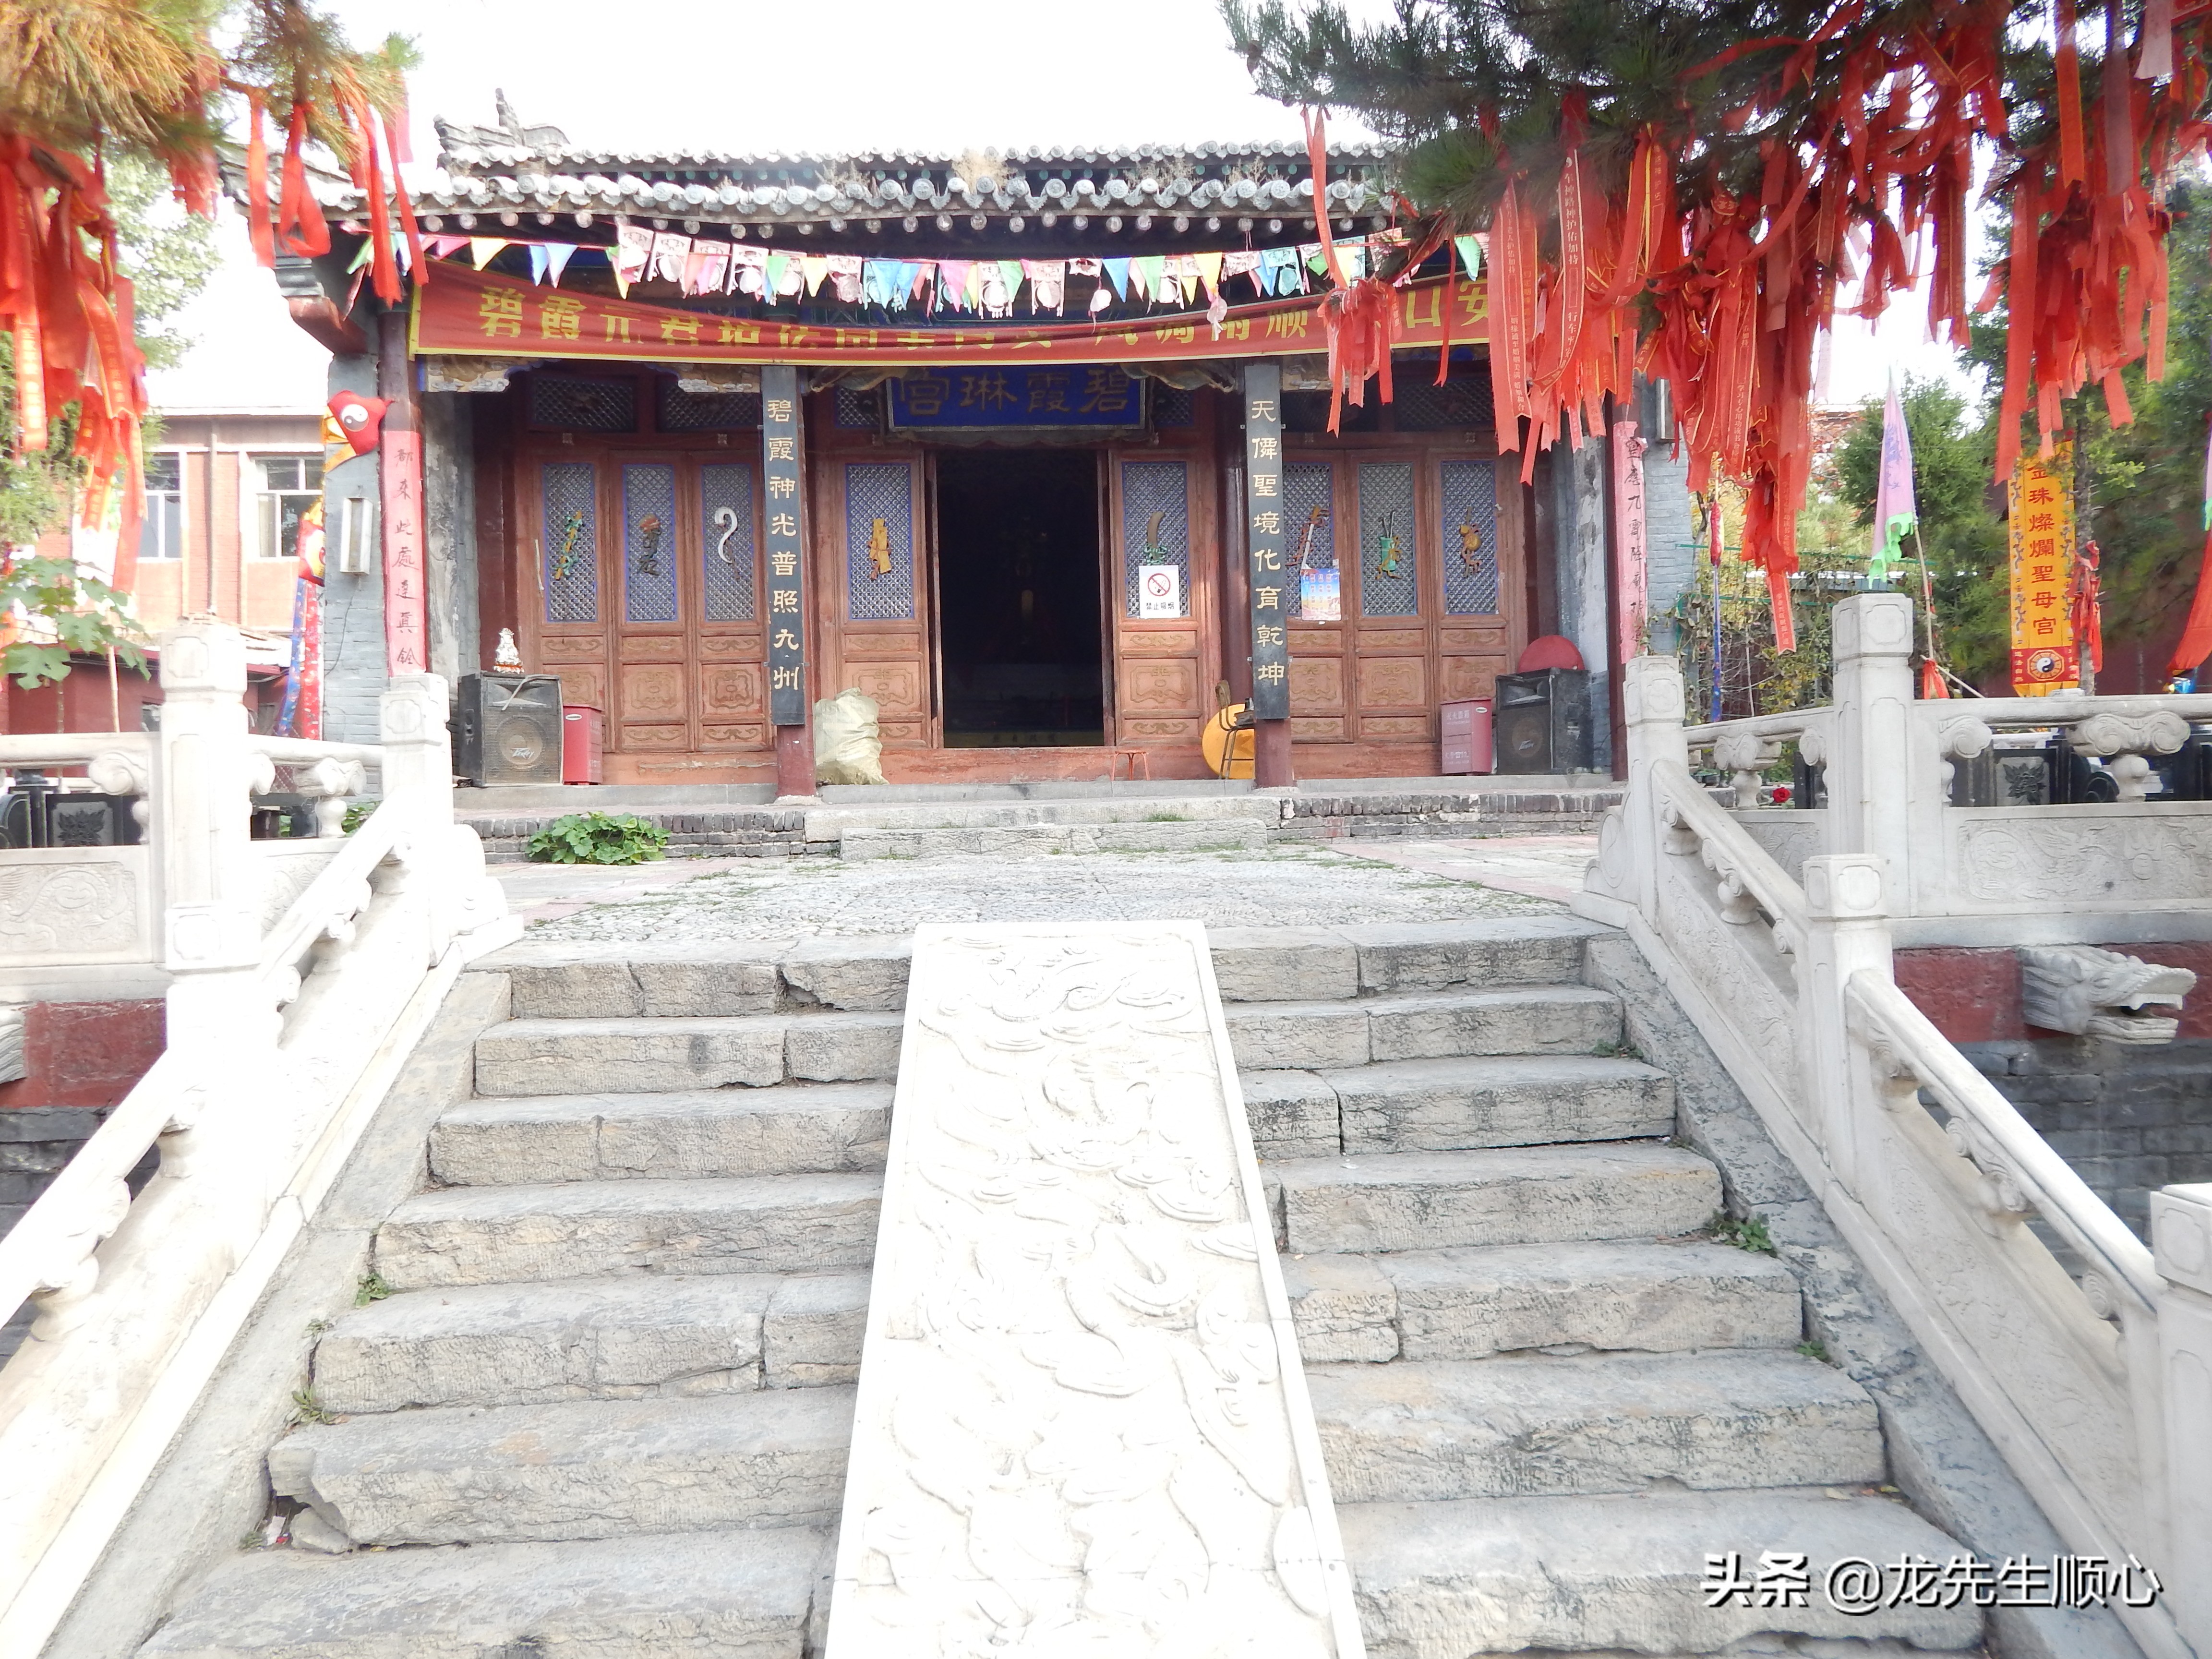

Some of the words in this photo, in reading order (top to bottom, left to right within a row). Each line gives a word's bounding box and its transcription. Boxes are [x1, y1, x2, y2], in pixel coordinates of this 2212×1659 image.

[767, 399, 799, 690] 碧霞神光普照九州
